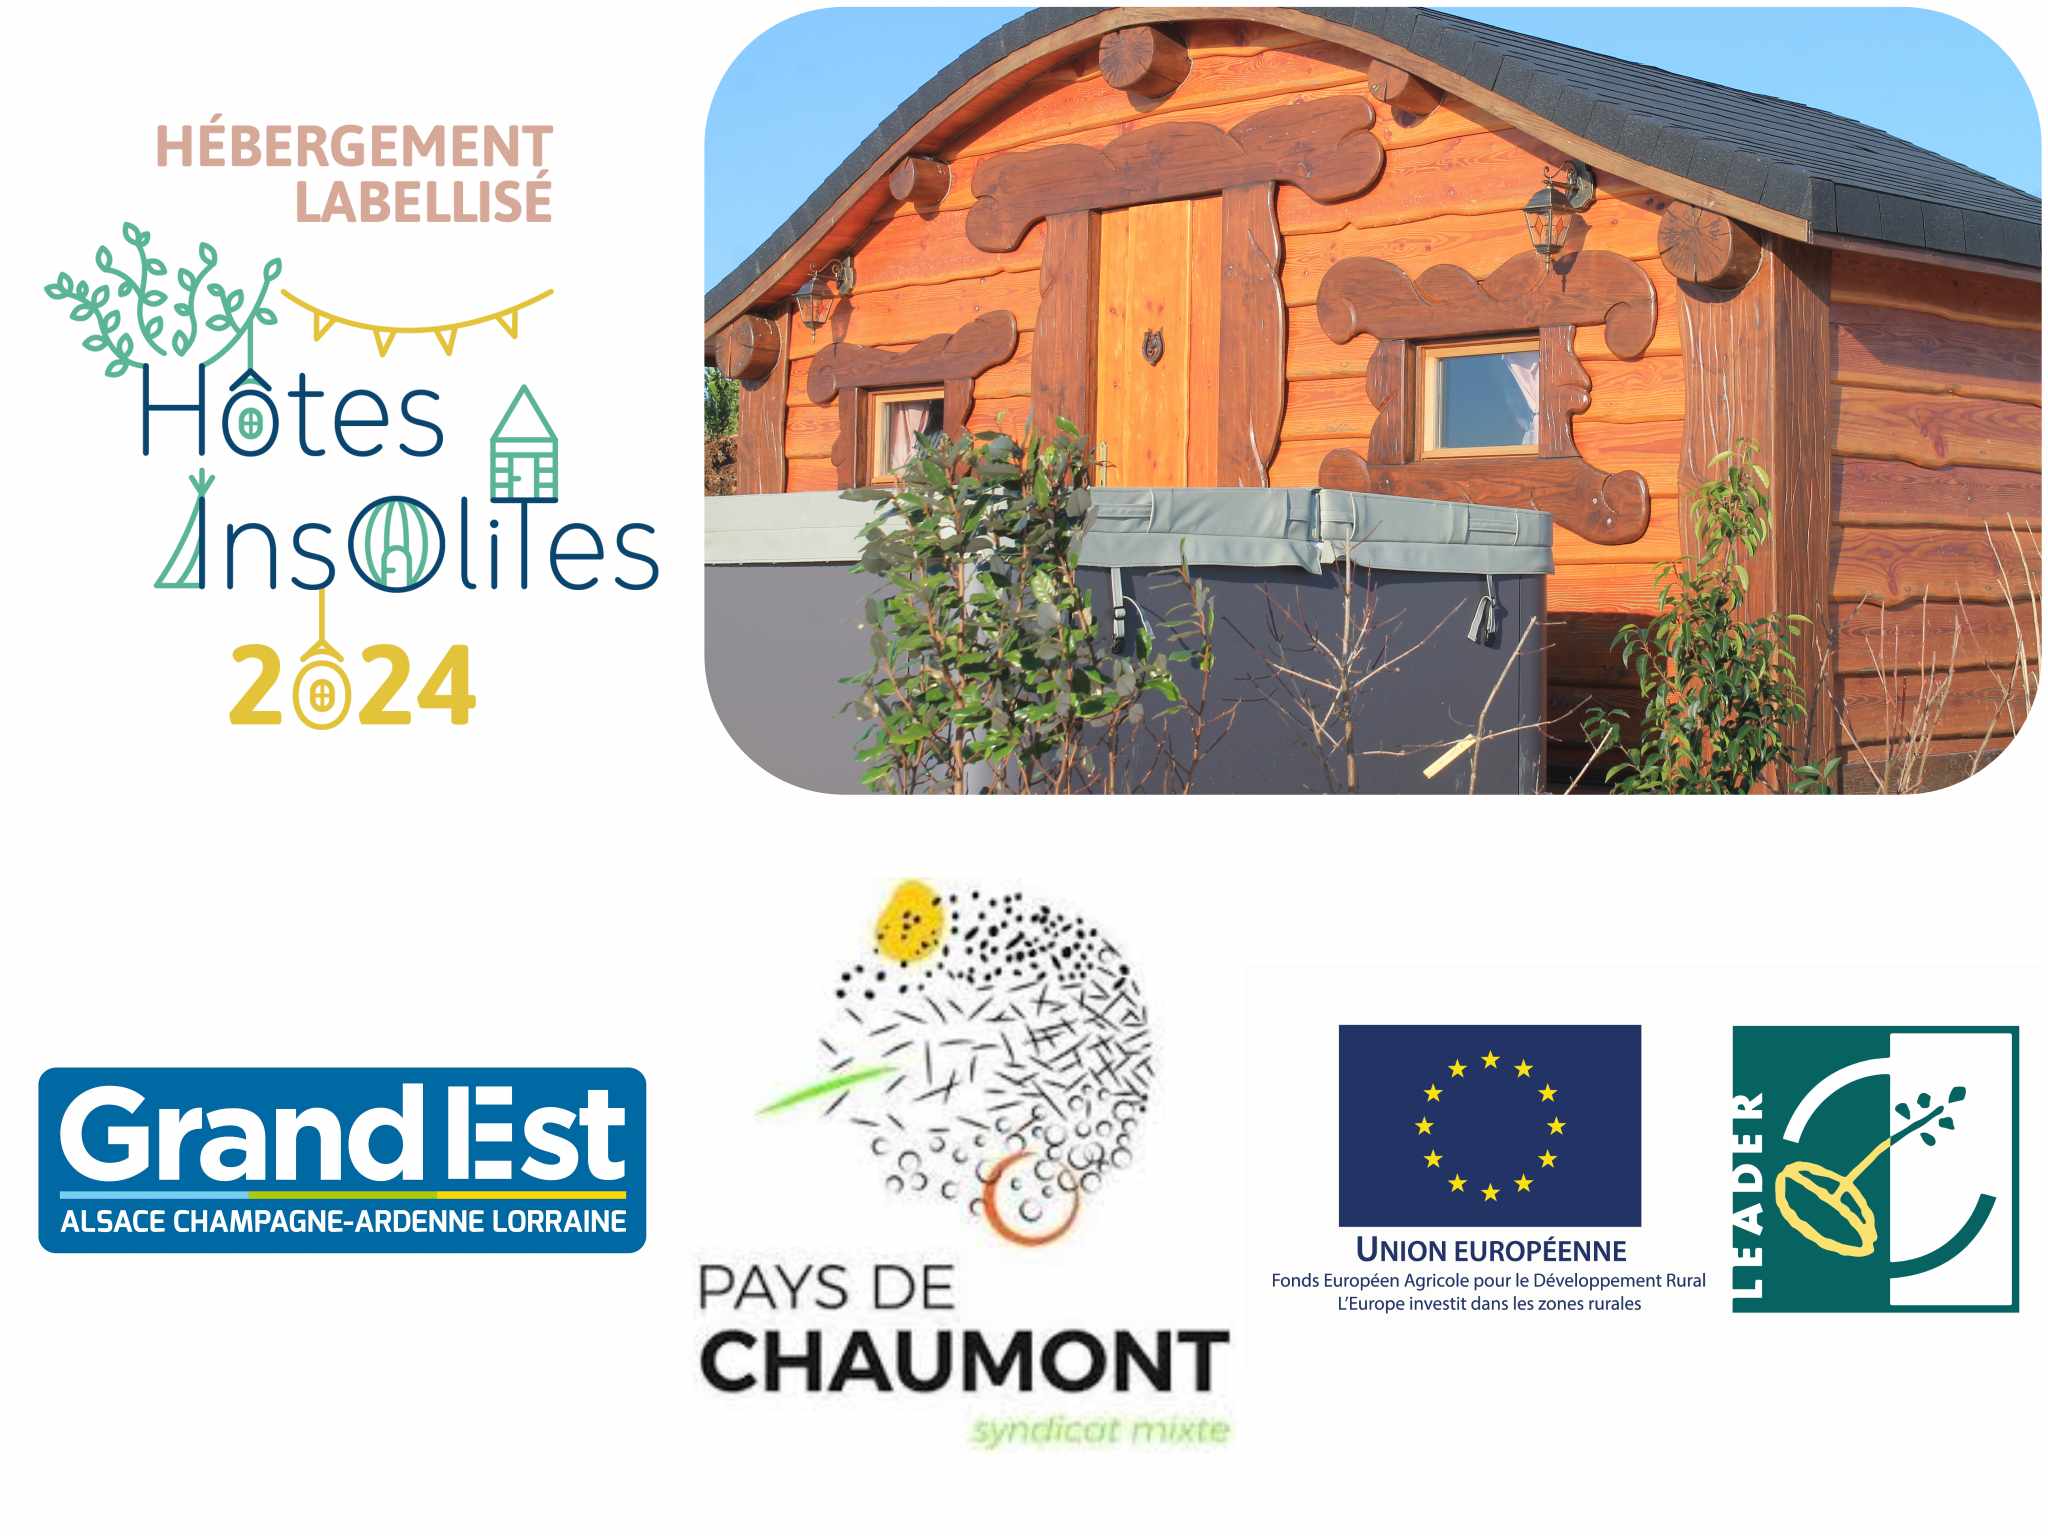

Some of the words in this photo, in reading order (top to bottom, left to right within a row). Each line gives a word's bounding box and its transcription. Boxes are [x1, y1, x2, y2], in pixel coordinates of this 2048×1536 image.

[157, 113, 554, 168] HÉBERGEMENT
[296, 170, 553, 223] LABELLISÉ
[142, 363, 444, 457] Hôtes
[61, 1083, 424, 1181] Grand
[447, 1086, 626, 1181] Est
[61, 1209, 165, 1233] ALSACE
[173, 1209, 484, 1233] CHAMPAGNE-ARDENNE
[493, 1209, 627, 1233] LORRAINE
[1733, 1092, 1764, 1300] LEADER
[1356, 1236, 1447, 1263] UNION
[1454, 1235, 1627, 1263] EUROPÉENNE
[699, 1264, 849, 1311] PAYS
[873, 1264, 956, 1311] DE
[1272, 1273, 1319, 1288] Fonds
[1324, 1273, 1400, 1292] Européen
[1404, 1273, 1470, 1292] Agricole
[1474, 1276, 1512, 1292] pour
[1515, 1272, 1530, 1288] le
[1533, 1272, 1663, 1292] Développement
[1667, 1272, 1706, 1288] Rural
[1409, 1296, 1468, 1311] investit
[1471, 1295, 1509, 1311] dans
[1513, 1295, 1535, 1311] les
[1538, 1299, 1585, 1311] zones
[1588, 1295, 1642, 1311] rurales
[699, 1328, 1231, 1395] CHAUMONT
[971, 1415, 1121, 1449] syndicat
[1132, 1416, 1232, 1444] mixte
